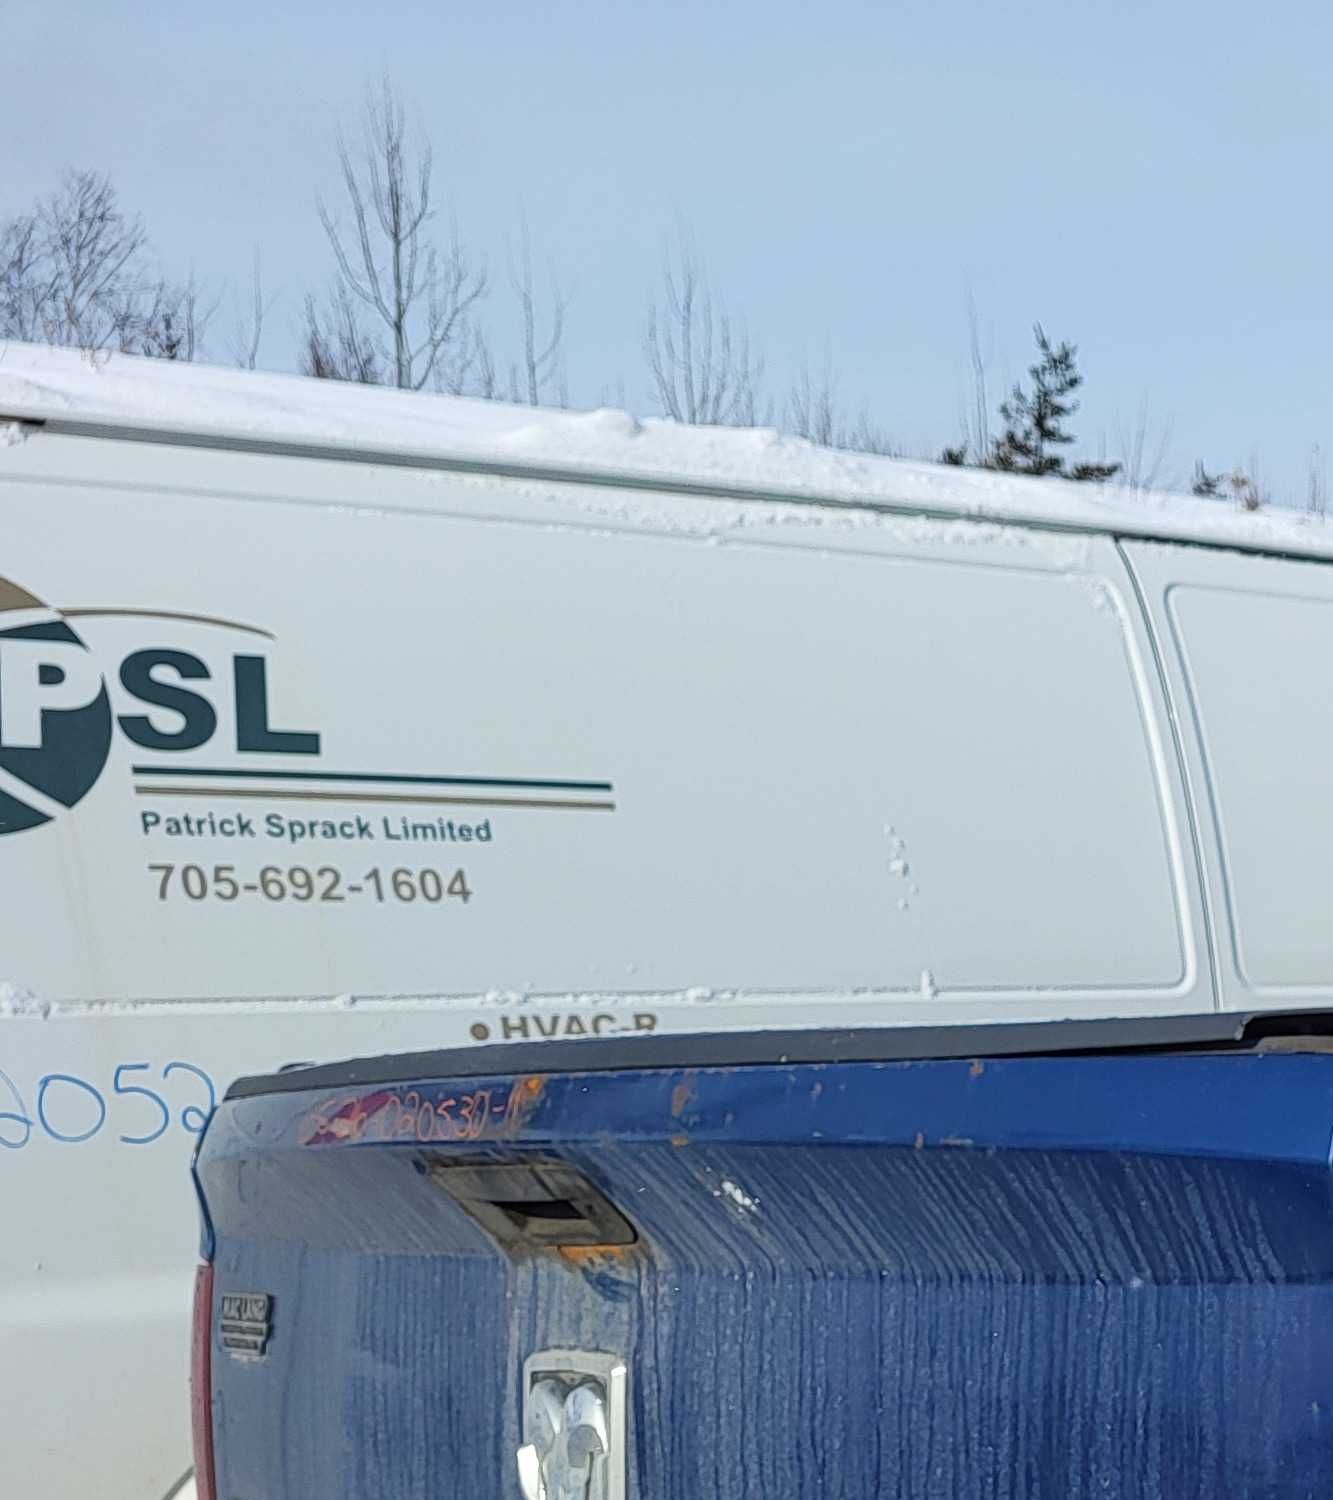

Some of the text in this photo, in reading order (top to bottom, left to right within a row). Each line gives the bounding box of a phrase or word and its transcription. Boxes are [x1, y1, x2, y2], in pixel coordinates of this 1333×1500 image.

[0, 638, 321, 756] PSL
[140, 811, 493, 844] Patrick Sprack Limited
[148, 864, 473, 903] 705-692-1604
